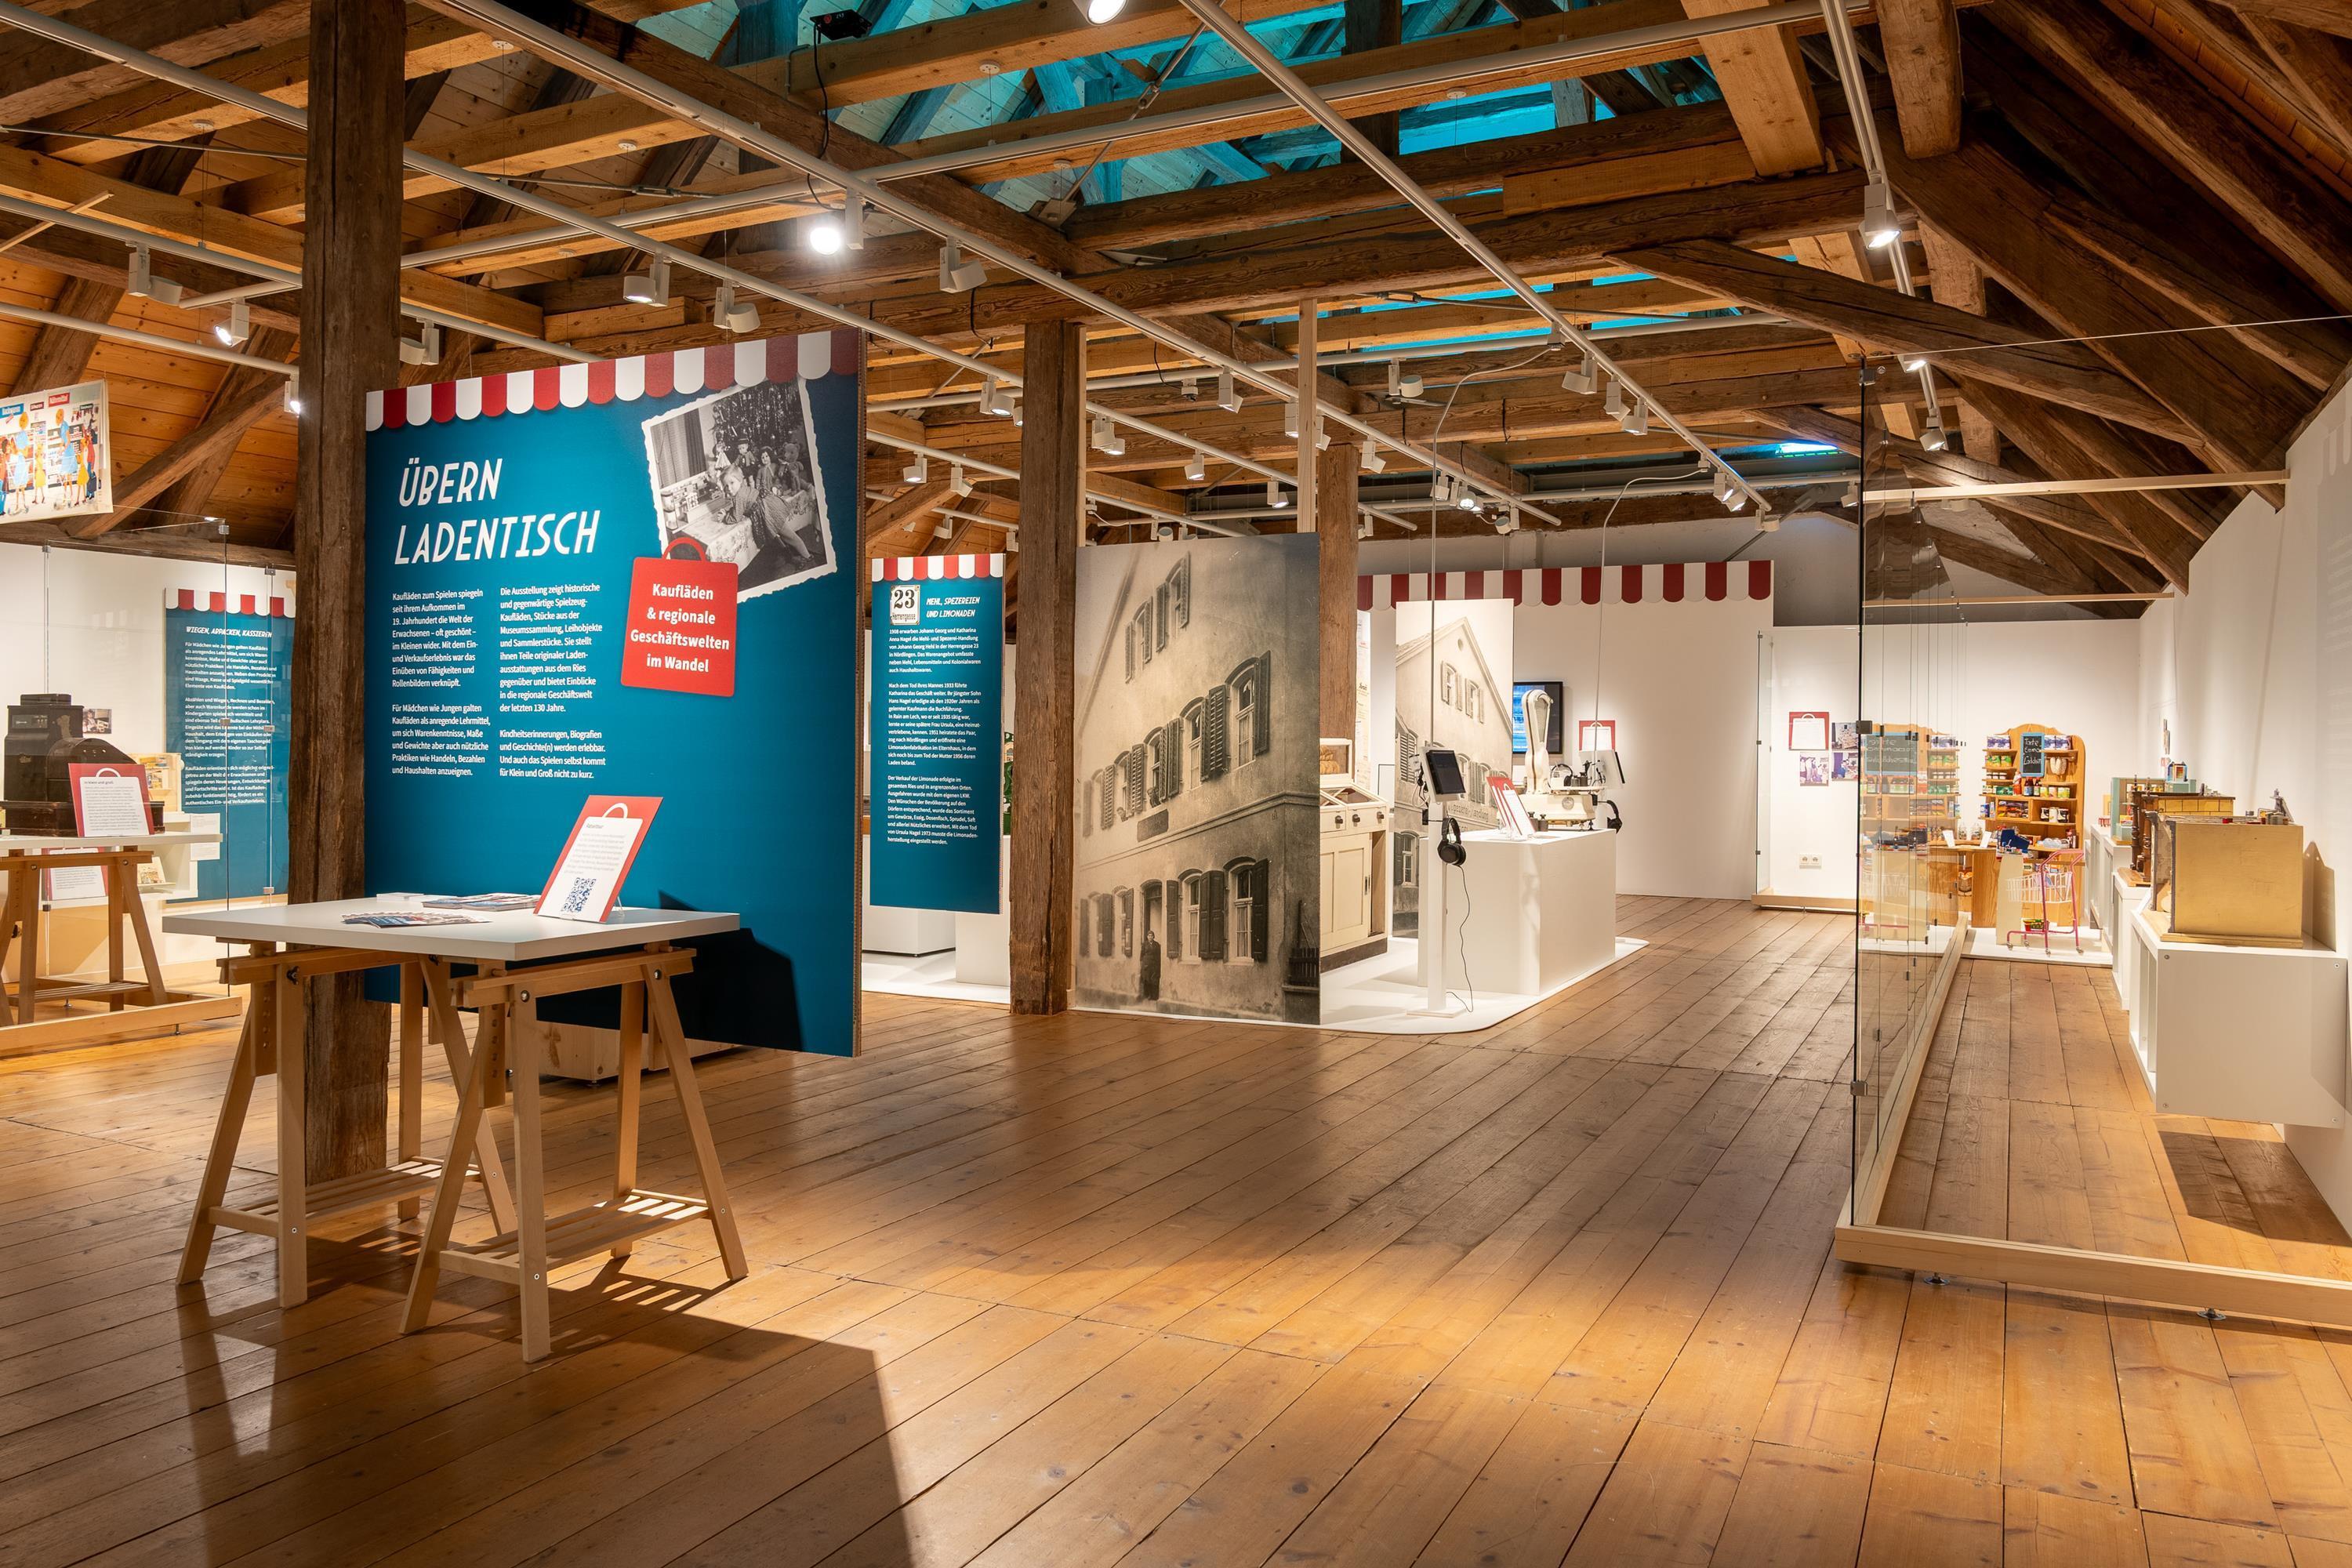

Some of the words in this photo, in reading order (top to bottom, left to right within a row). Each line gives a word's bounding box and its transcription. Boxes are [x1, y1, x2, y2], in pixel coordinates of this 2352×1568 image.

[399, 457, 503, 507] ÜBERN
[394, 510, 601, 564] LADENTISCH
[393, 592, 422, 601] Kaufläden
[435, 590, 458, 600] Spielen
[458, 589, 483, 600] spiegeln
[500, 587, 511, 596] Die
[511, 586, 548, 597] Ausstellung
[548, 585, 564, 596] zeigt
[564, 583, 601, 593] historische
[652, 583, 713, 601] Kaufläden
[500, 600, 513, 608] und
[513, 599, 554, 610] gegenwärtige
[555, 597, 586, 608] Spielzeug-
[894, 590, 915, 609] 23
[927, 597, 943, 606] MEHL,
[944, 596, 980, 605] SPEZEREIEN
[421, 603, 456, 612] Aufkommen
[500, 612, 533, 622] Kaufläden,
[533, 612, 555, 620] Stücke
[568, 611, 579, 619] der
[647, 607, 656, 620] &
[659, 608, 716, 625] regionale
[939, 609, 976, 618] LIMONADEN
[403, 616, 437, 625] Jahrhundert
[448, 615, 463, 623] Welt
[435, 628, 444, 637] oft
[445, 627, 472, 638] geschönt
[500, 625, 564, 636] Museumssammlung,
[564, 623, 602, 634] Leihobjekte
[466, 640, 478, 648] Ein-
[513, 638, 563, 647] Sammlerstücke.
[564, 637, 575, 646] Sie
[575, 637, 592, 645] stellt
[630, 630, 730, 650] Geschäftswelten
[500, 652, 517, 660] ihnen
[534, 651, 565, 662] originaler
[565, 650, 588, 659] Laden-
[647, 653, 662, 667] im
[665, 655, 709, 673] Wandel
[428, 666, 462, 677] Fähigkeiten
[499, 666, 544, 675] ausstattungen
[572, 663, 586, 672] Ries
[431, 678, 460, 688] verknüpft.
[499, 677, 532, 688] gegenüber
[533, 677, 546, 686] und
[566, 677, 596, 685] Einblicke
[517, 691, 547, 701] regionale
[547, 690, 593, 699] Geschäftswelt
[441, 705, 463, 713] Jungen
[463, 704, 482, 714] galten
[499, 703, 510, 712] der
[511, 703, 533, 712] letzten
[546, 703, 565, 712] Jahre.
[429, 717, 459, 727] anregende
[459, 717, 490, 726] Lehrmittel,
[415, 729, 466, 738] Warenkenntnisse,
[466, 729, 483, 738] Maße
[499, 730, 569, 740] Kindheitserinnerungen,
[570, 730, 602, 741] Biografien
[461, 742, 489, 750] nützliche
[512, 742, 554, 753] Geschichte(n)
[577, 743, 605, 752] erlebbar.
[430, 754, 457, 764] Handeln,
[499, 755, 513, 764] Und
[540, 756, 564, 766] Spielen
[564, 757, 583, 765] selbst
[583, 757, 606, 765] kommt
[437, 768, 472, 778] anzueignen.
[499, 768, 509, 776] für
[509, 768, 524, 777] Klein
[524, 768, 538, 777] und
[538, 768, 554, 778] Groß
[554, 769, 570, 778] nicht
[579, 770, 594, 779] kurz.
